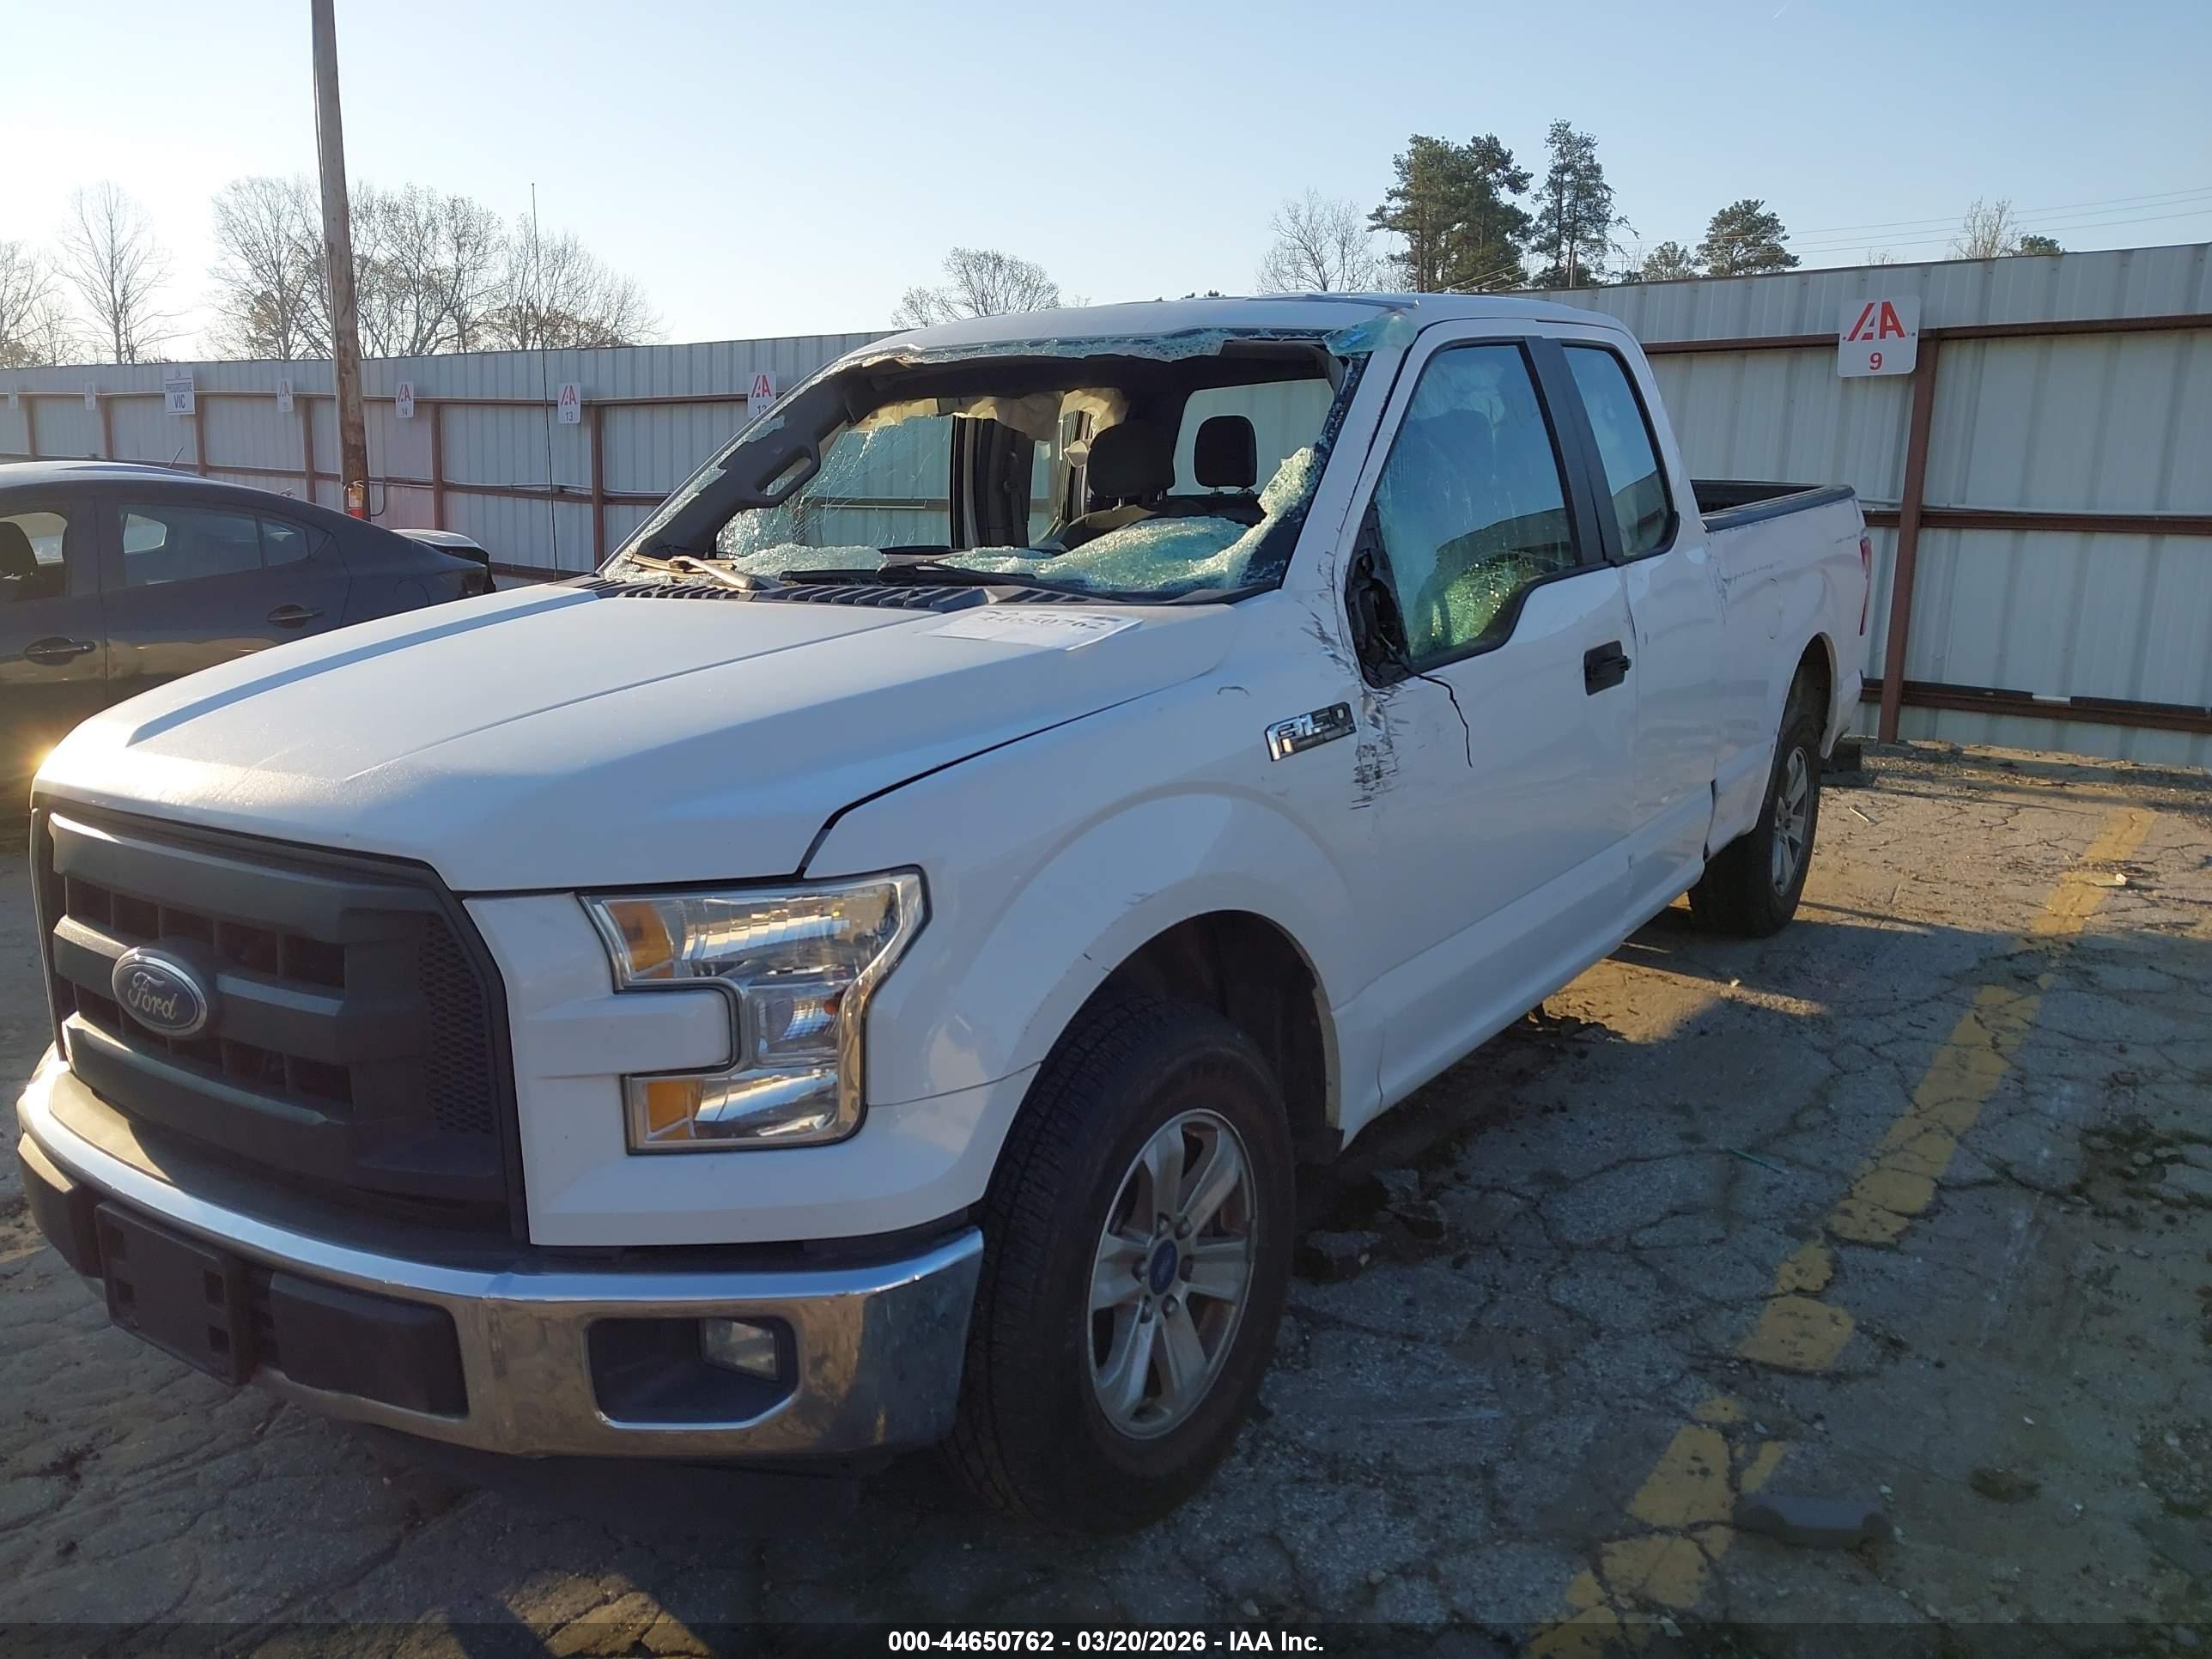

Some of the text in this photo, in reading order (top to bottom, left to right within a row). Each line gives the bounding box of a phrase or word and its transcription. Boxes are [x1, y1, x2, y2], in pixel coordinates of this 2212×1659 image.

[1869, 352, 1883, 371] 9
[173, 393, 185, 409] VIC
[127, 971, 179, 1019] Ford
